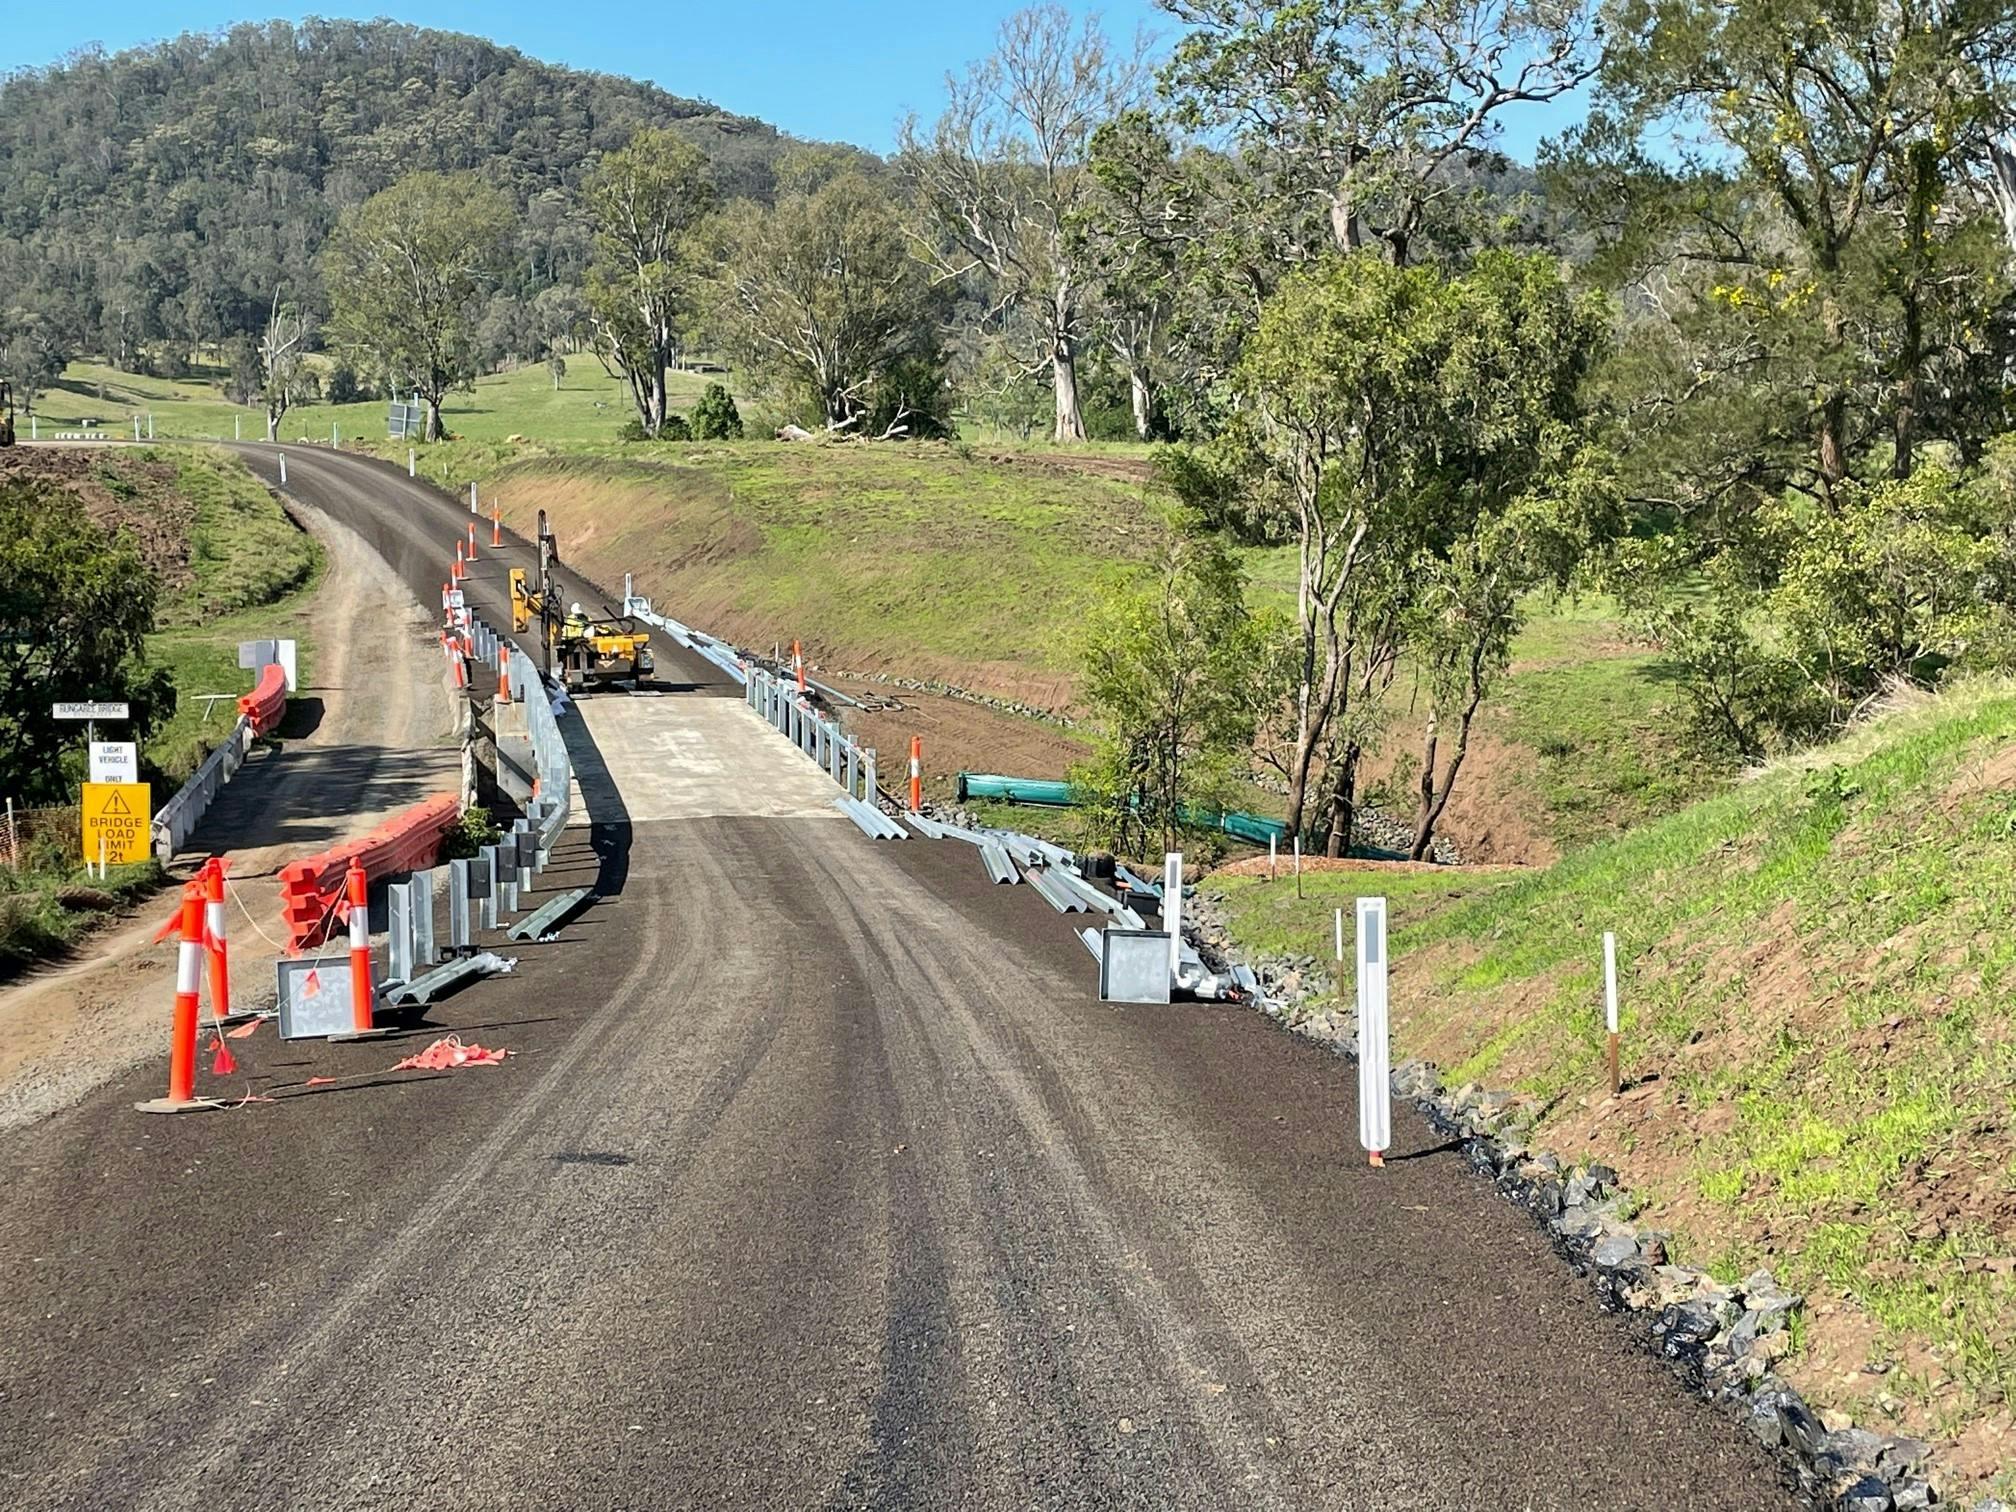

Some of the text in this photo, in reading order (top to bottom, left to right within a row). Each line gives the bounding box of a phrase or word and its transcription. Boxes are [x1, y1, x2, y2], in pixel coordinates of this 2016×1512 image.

[98, 703, 123, 713] BRIDGE
[103, 746, 122, 754] LIGHT
[99, 756, 128, 764] VEHICLE
[90, 817, 143, 827] BRIDGE
[97, 829, 135, 839] LOAD
[98, 840, 135, 849] LIMIT
[109, 851, 124, 862] 2t
